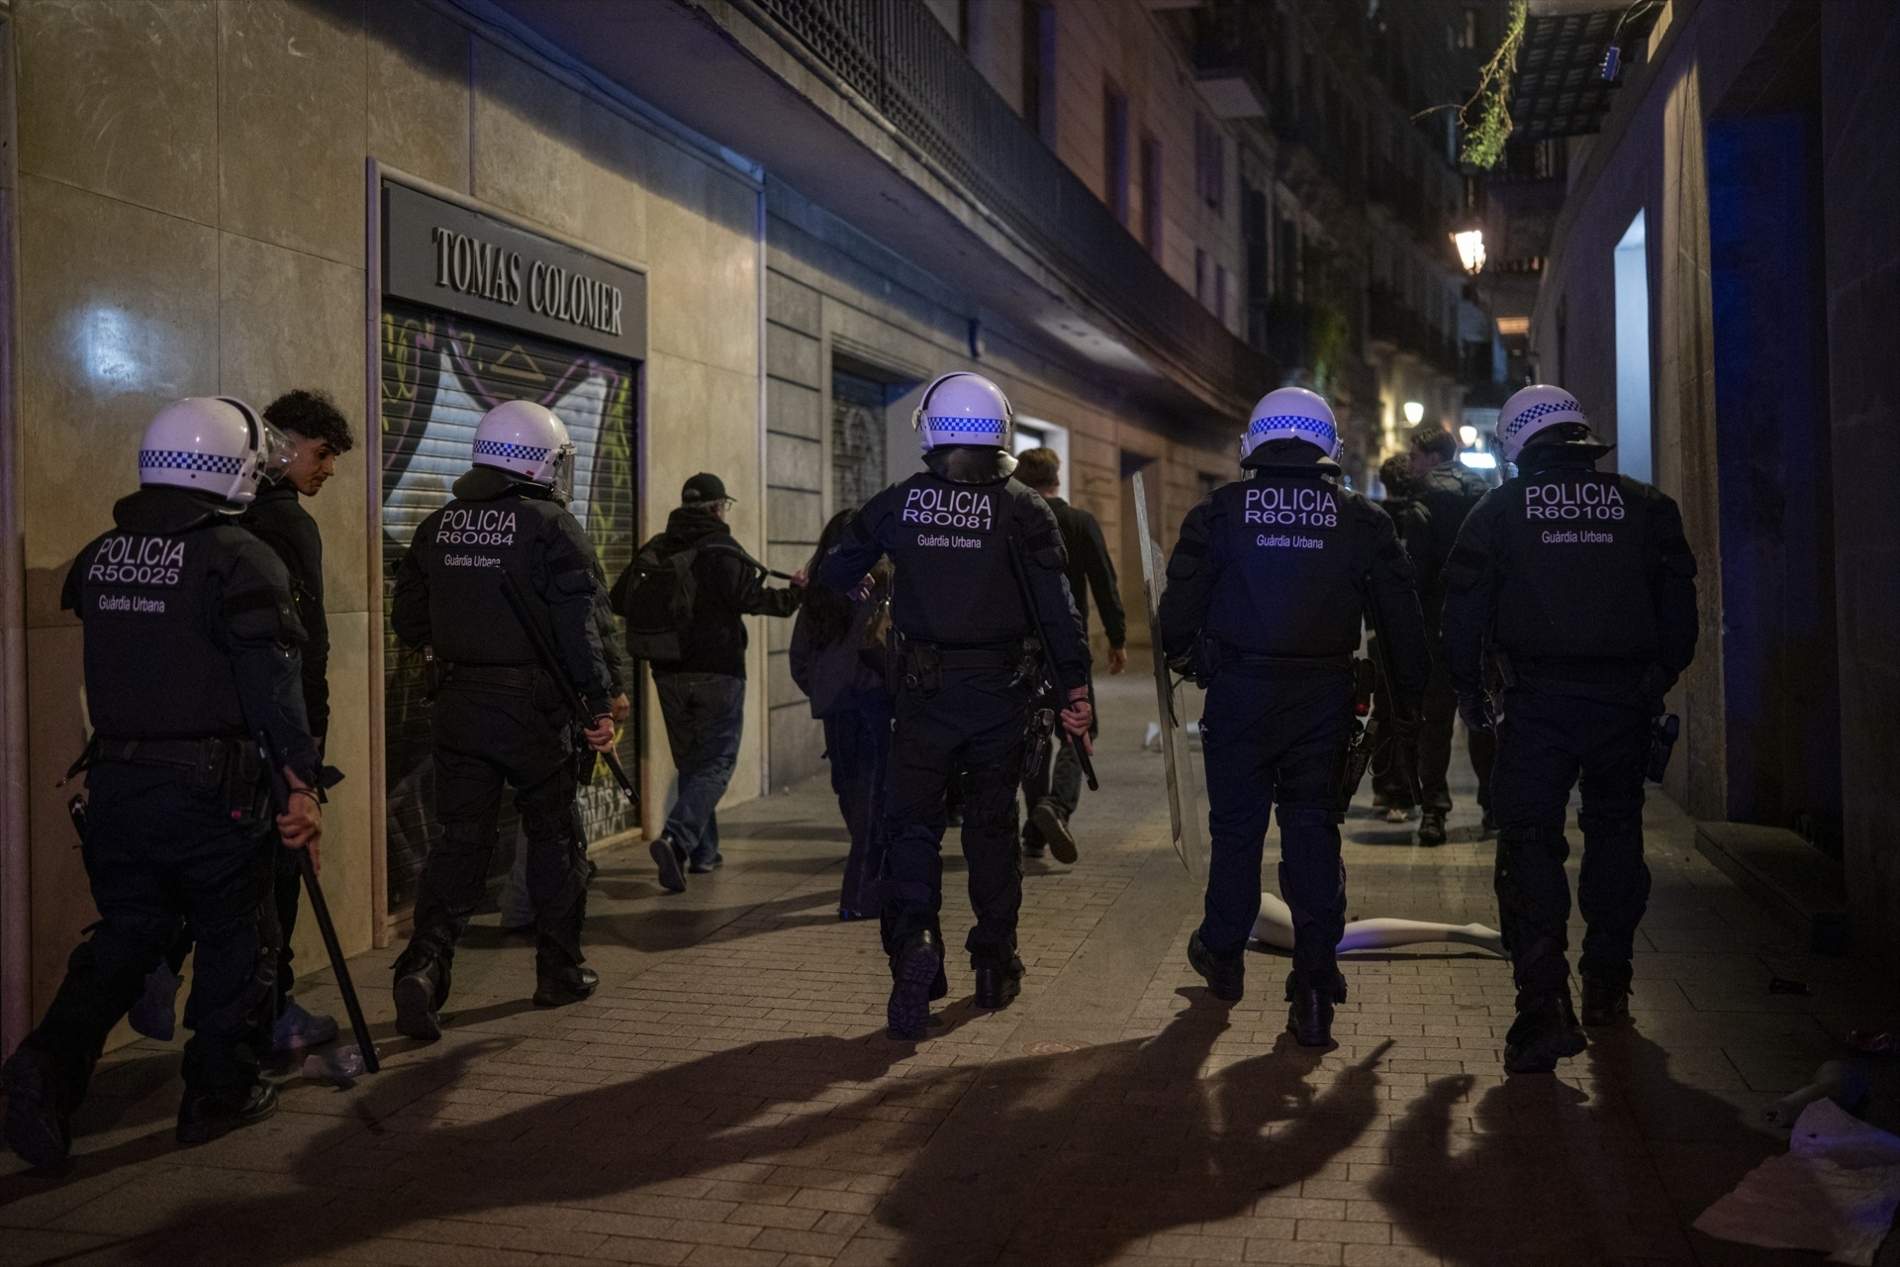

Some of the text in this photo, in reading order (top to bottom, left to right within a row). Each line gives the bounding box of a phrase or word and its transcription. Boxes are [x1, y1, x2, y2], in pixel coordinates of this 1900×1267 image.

[434, 227, 622, 336] TOMAS COLOMER
[905, 488, 992, 516] POLICIA
[1245, 487, 1337, 513] POLICIA
[1525, 483, 1624, 505] POLICIA
[439, 509, 516, 532] POLICIA
[951, 536, 982, 549] Urbana
[1292, 536, 1324, 549] Urbana
[1580, 531, 1614, 543] Urbana
[94, 536, 185, 567] POLICIA
[132, 597, 165, 613] Urbana
